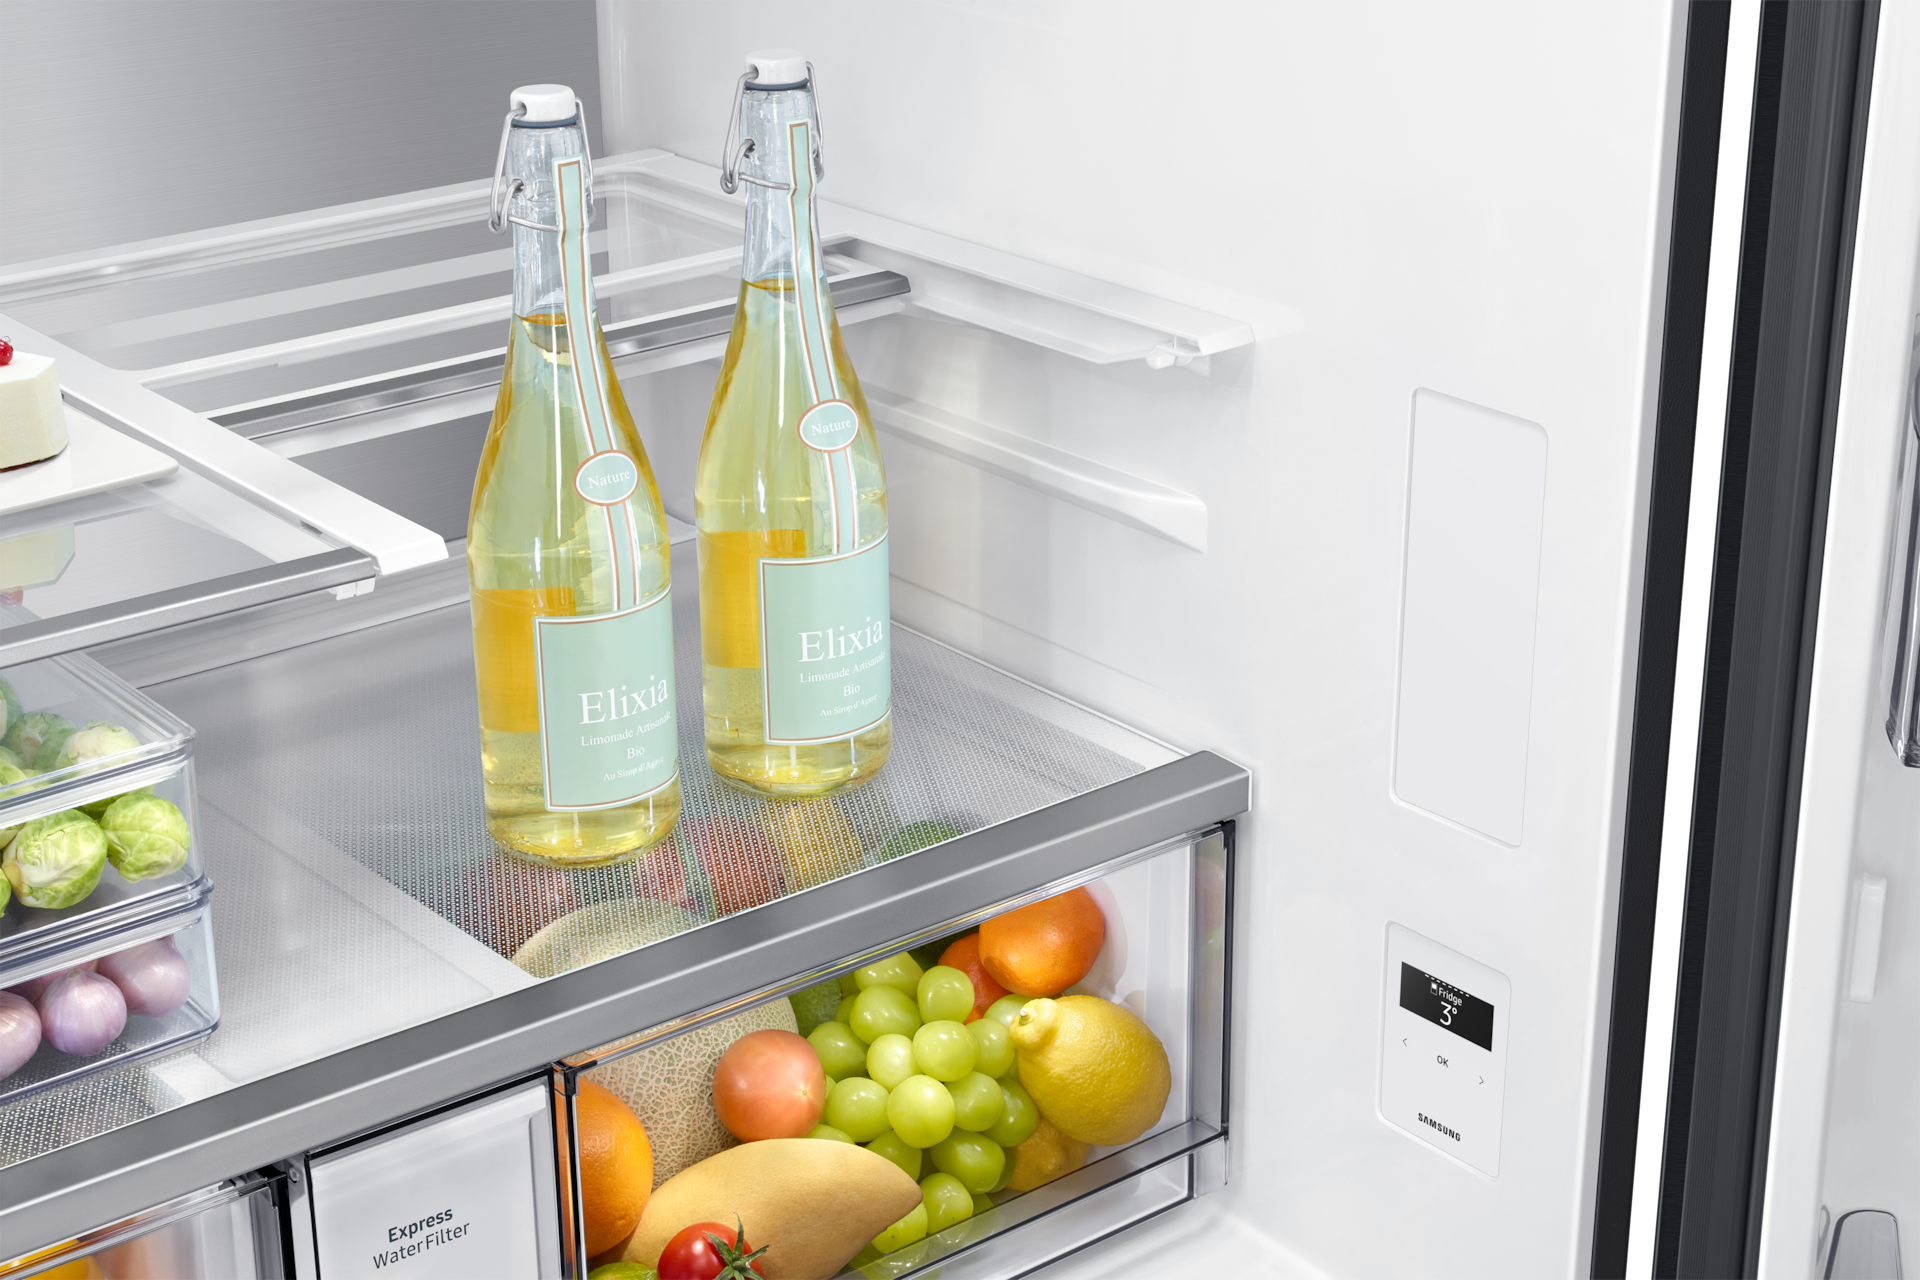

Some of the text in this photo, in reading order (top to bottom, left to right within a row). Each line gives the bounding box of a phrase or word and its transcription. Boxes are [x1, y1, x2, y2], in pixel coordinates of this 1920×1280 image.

[810, 419, 851, 436] Nature
[587, 470, 630, 489] Nature
[797, 616, 883, 662] Elixia
[800, 650, 886, 683] Limonade Artisanale
[843, 683, 861, 697] Bio
[577, 675, 668, 725] Elixia
[820, 709, 832, 717] Au
[833, 704, 853, 714] Sirop
[581, 729, 634, 746] Limonade
[627, 745, 645, 759] Bio
[603, 773, 616, 781] Au
[617, 767, 637, 779] Sirop
[1438, 987, 1462, 1006] Fridge
[1436, 1055, 1449, 1068] OK
[1417, 1112, 1461, 1142] SAMSUNG
[388, 1208, 453, 1243] Express
